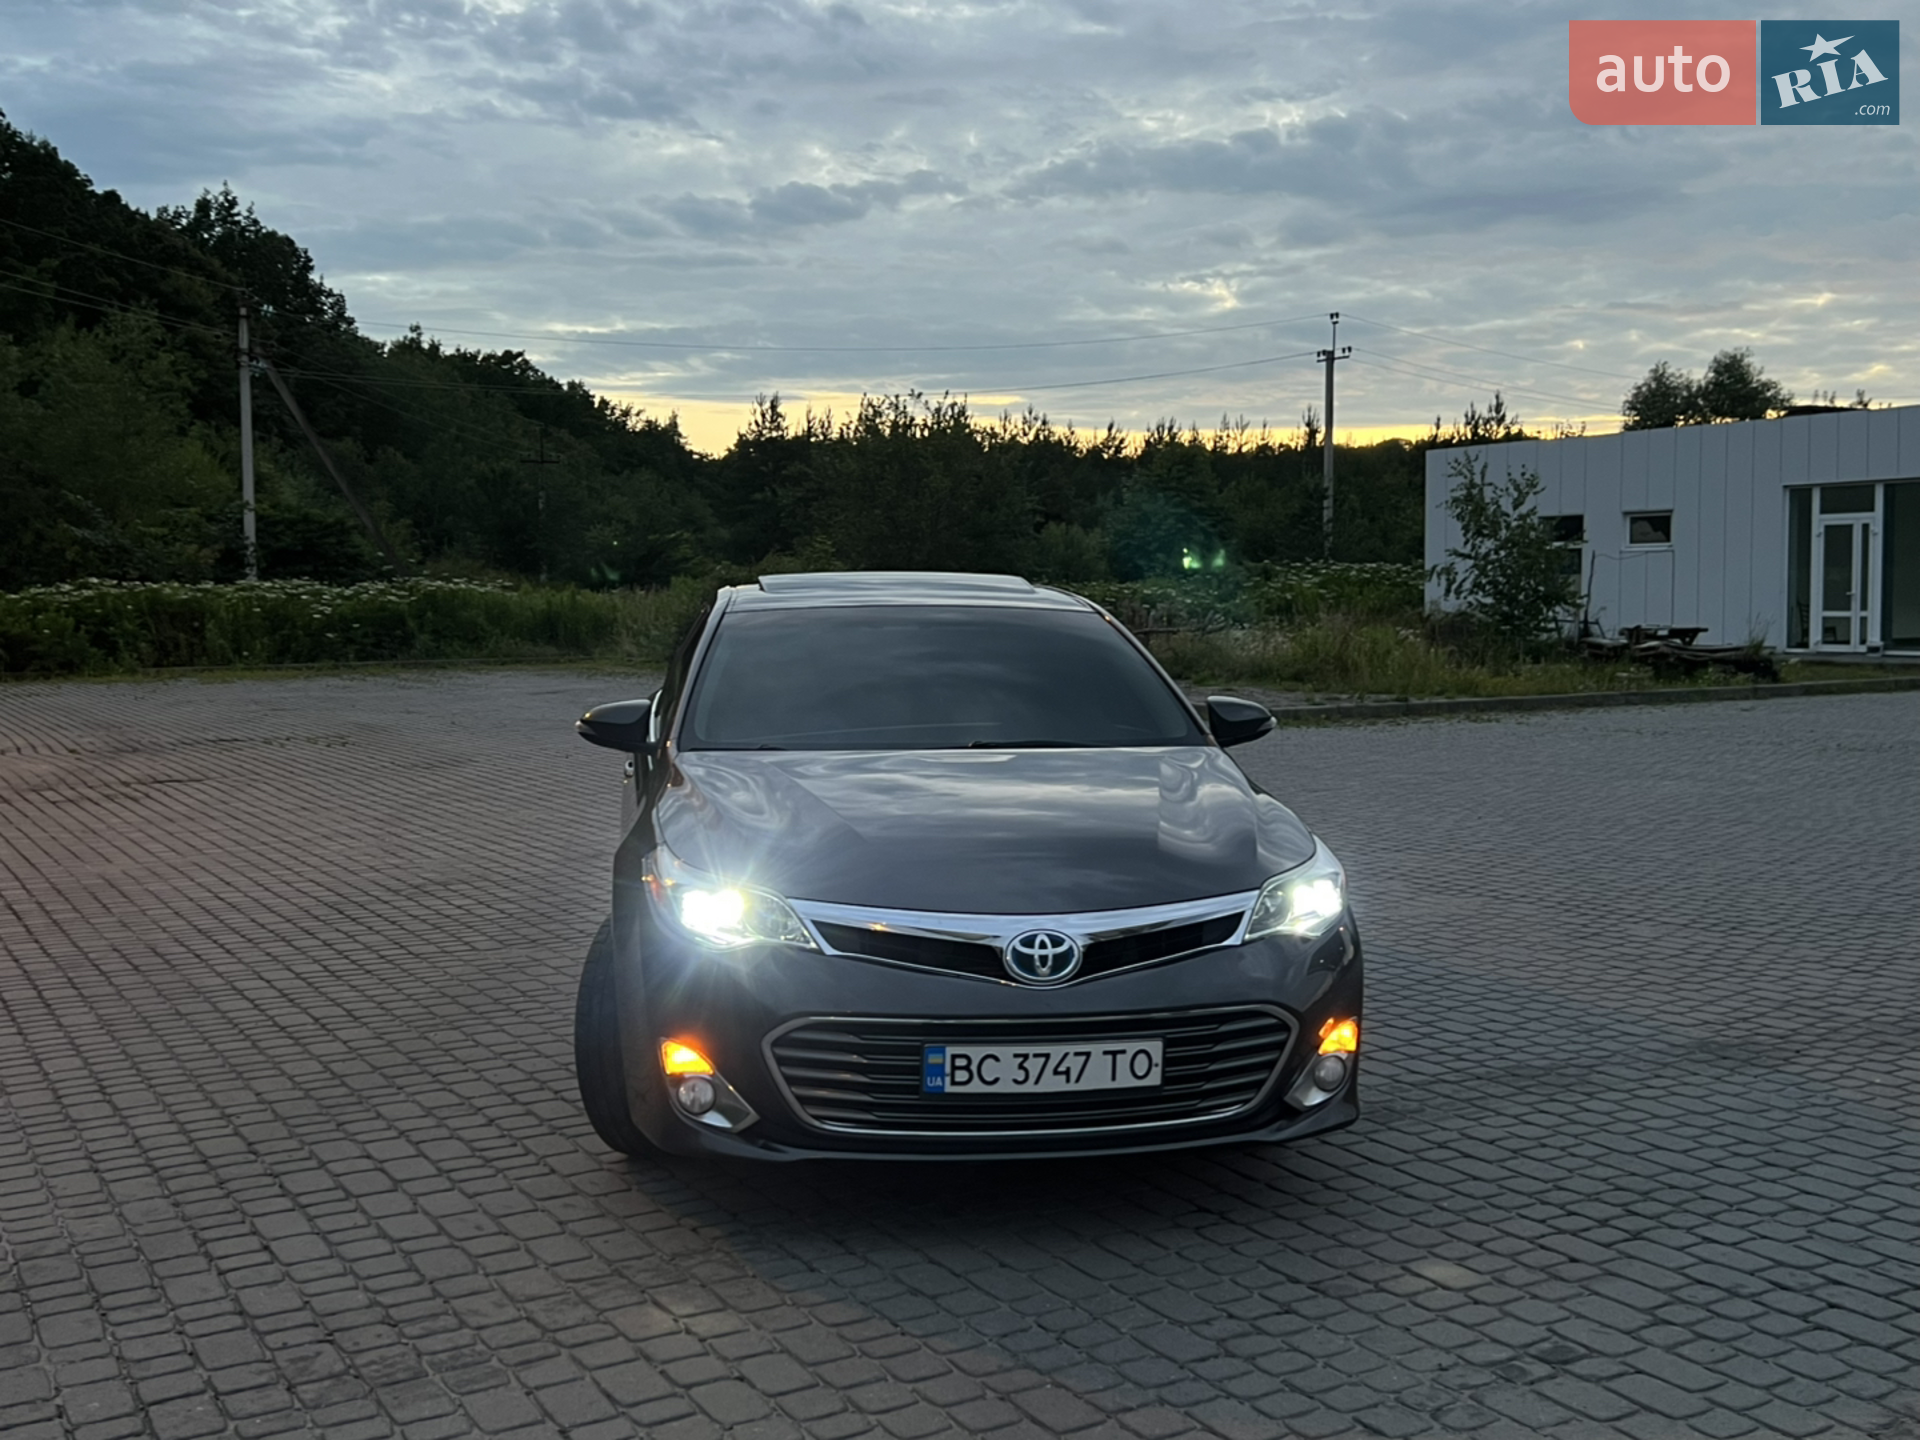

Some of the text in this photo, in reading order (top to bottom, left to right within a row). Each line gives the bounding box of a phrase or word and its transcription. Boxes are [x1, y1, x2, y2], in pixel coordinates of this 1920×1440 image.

[950, 1048, 1154, 1087] BC 3747 TO
[927, 1076, 943, 1087] UA
